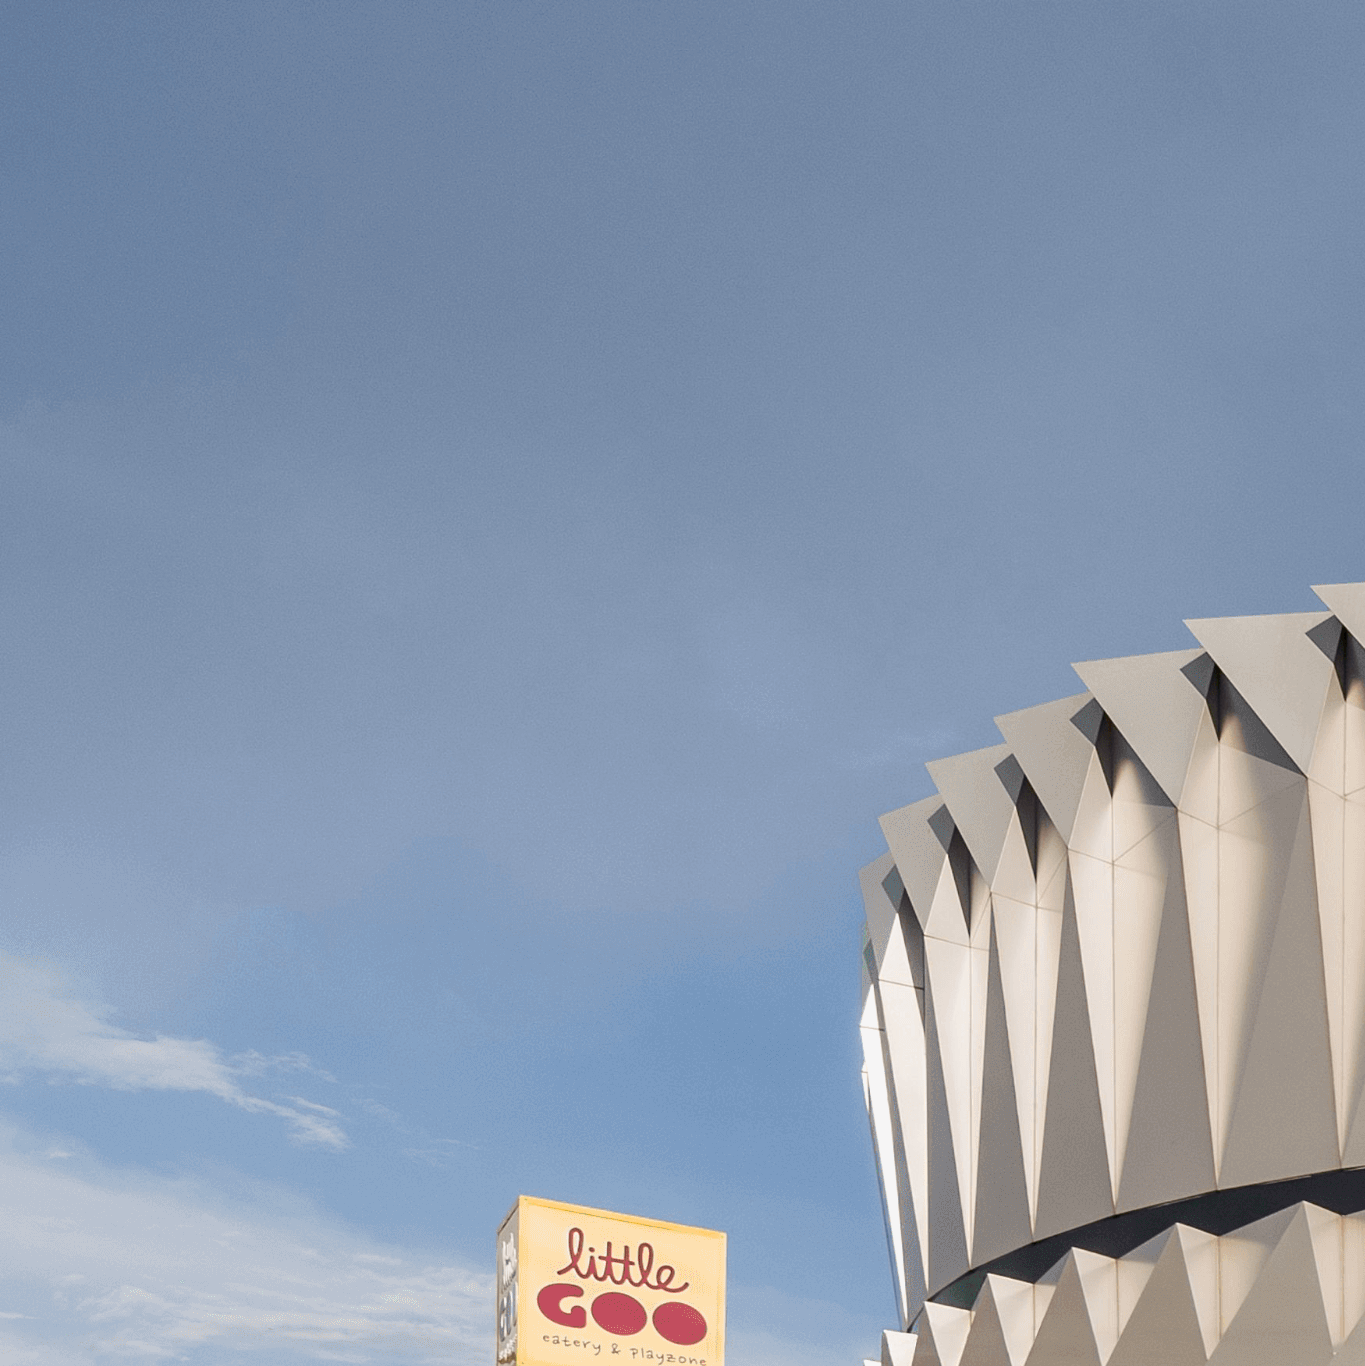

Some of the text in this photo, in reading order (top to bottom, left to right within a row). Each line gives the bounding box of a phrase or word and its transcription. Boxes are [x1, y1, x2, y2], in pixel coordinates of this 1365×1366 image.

[557, 1227, 690, 1293] little
[542, 1334, 707, 1366] eatery & playzone
